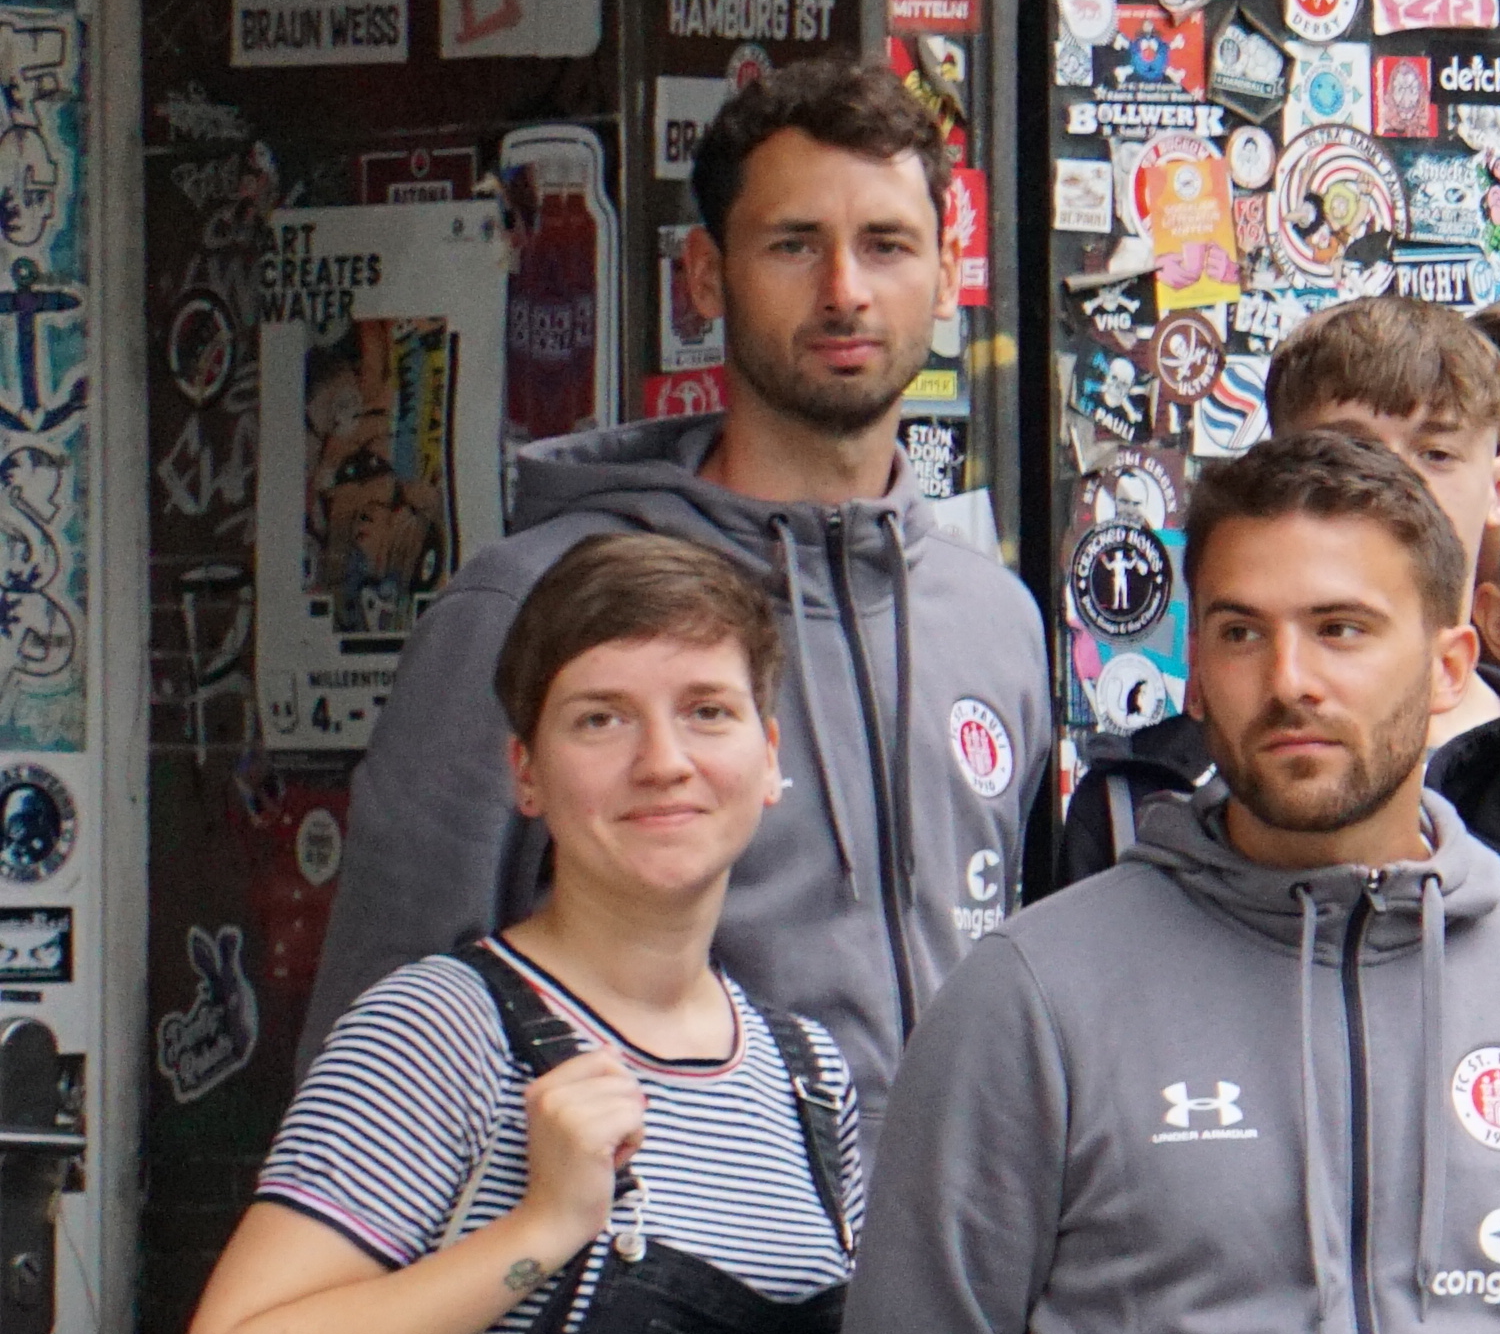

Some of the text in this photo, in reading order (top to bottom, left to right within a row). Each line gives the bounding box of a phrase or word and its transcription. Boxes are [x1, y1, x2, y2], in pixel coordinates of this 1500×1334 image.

[242, 4, 322, 52] BRAUN
[1291, 12, 1341, 37] DERBY
[1067, 102, 1226, 136] BOLLWERK
[259, 254, 382, 289] CREATES
[1455, 1074, 1470, 1094] FC
[1467, 1053, 1491, 1072] ST.
